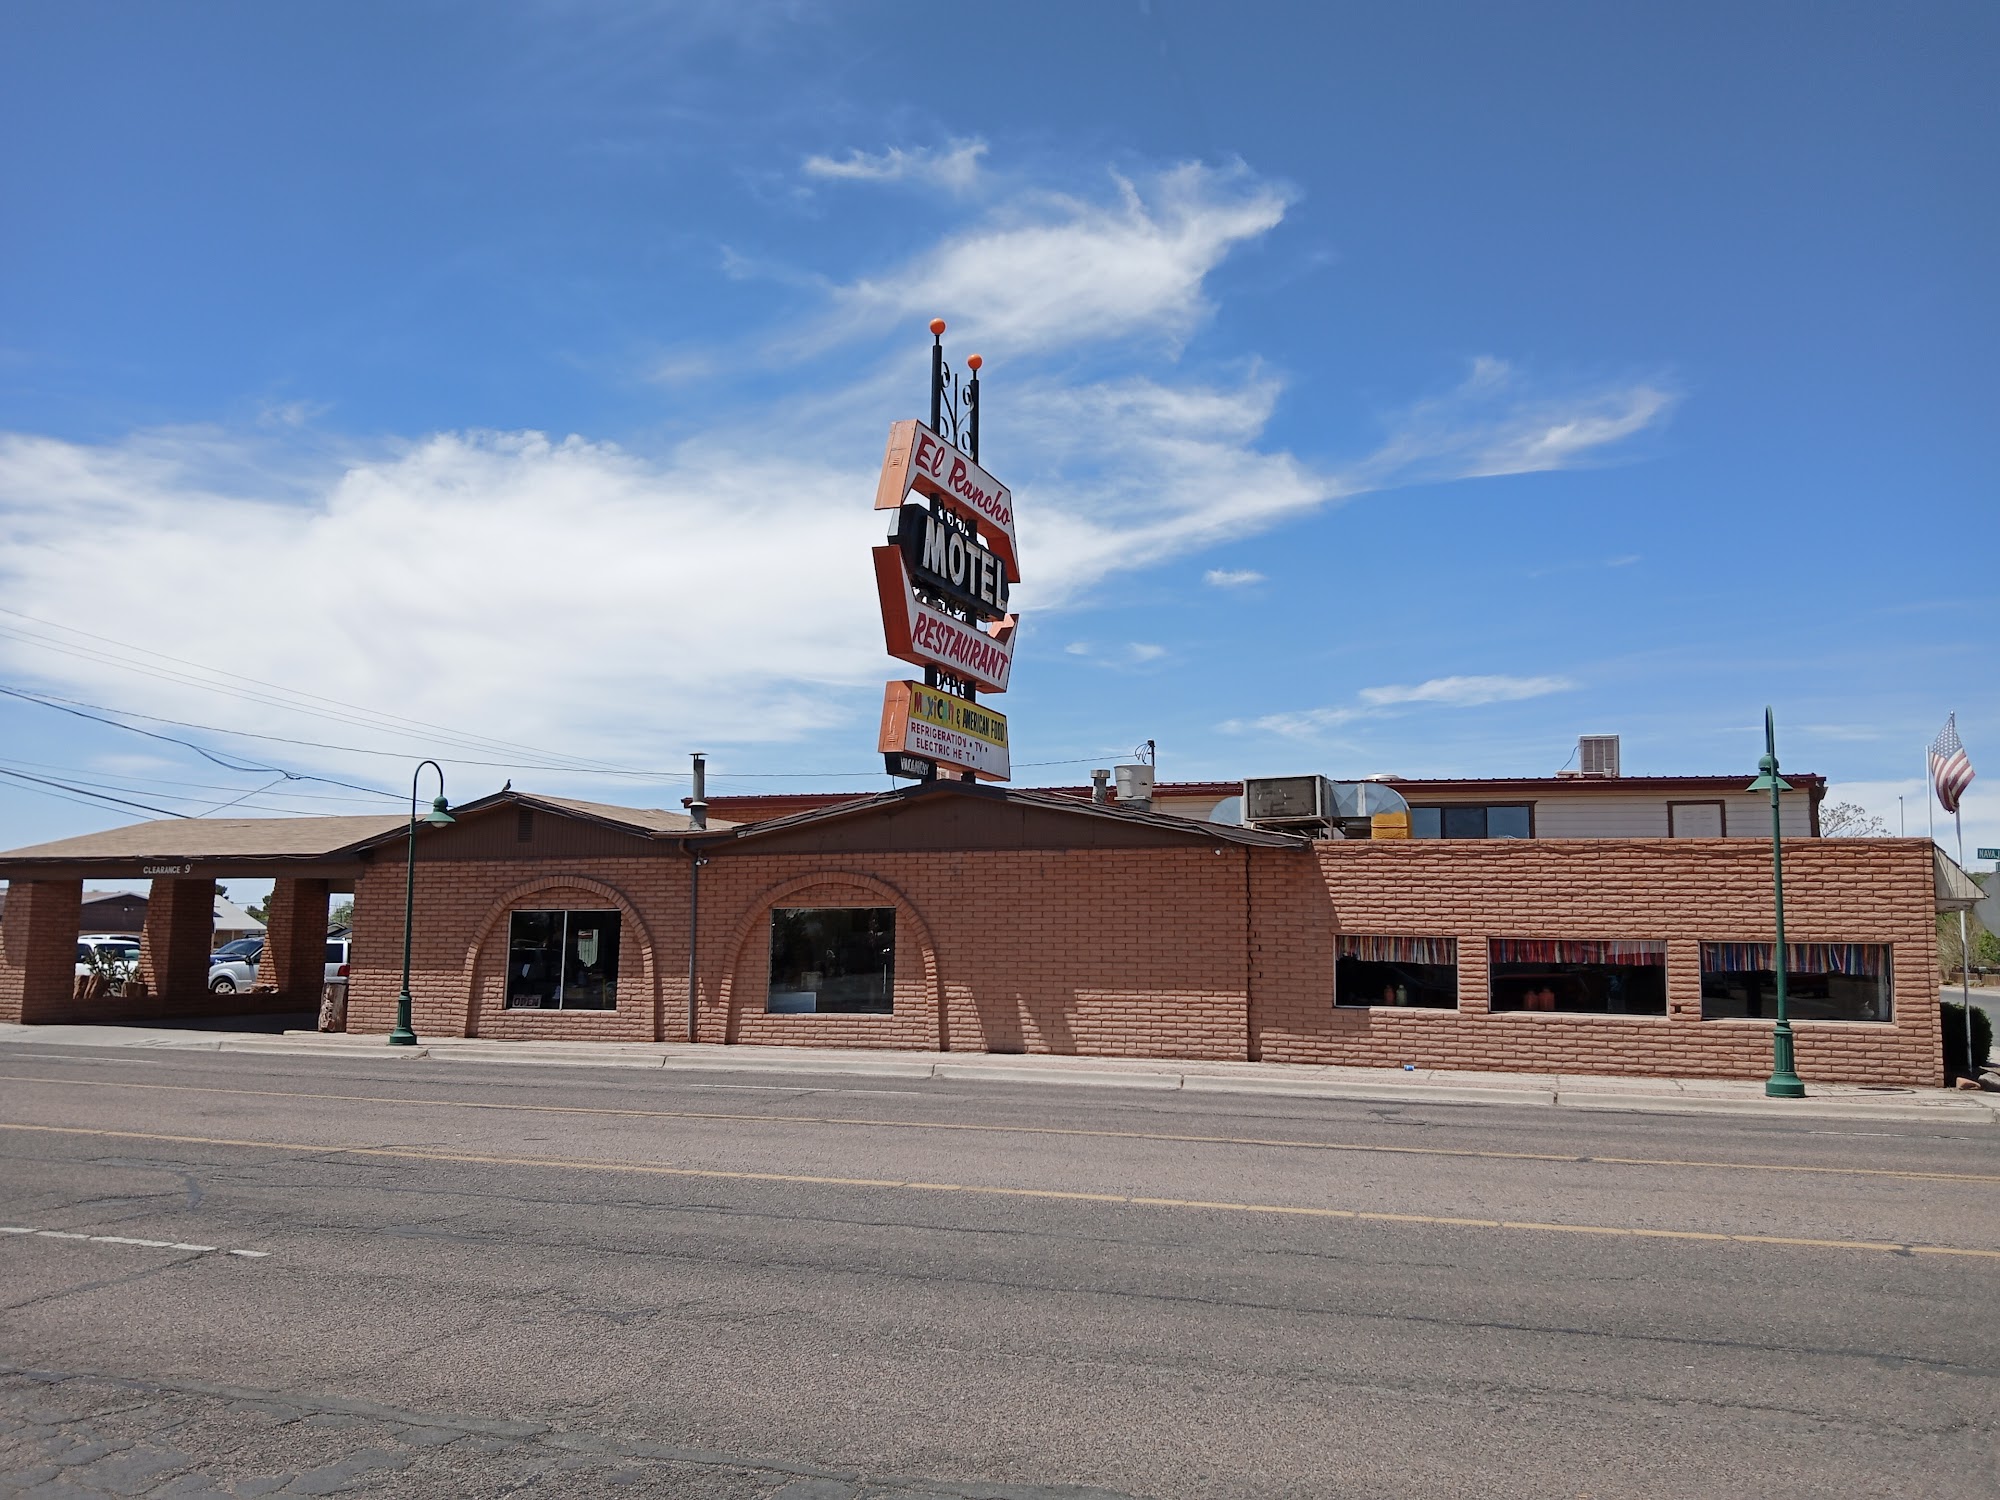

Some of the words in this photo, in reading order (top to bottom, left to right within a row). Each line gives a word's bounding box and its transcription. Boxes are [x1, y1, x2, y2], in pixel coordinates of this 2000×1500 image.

[914, 432, 946, 478] El
[947, 456, 1011, 526] Rancho
[922, 515, 1006, 612] MOTEL
[912, 611, 1009, 681] RESTAURANT
[911, 721, 967, 748] REFRIGERATION
[974, 741, 984, 753] TV
[962, 707, 989, 737] AMERICAN
[990, 719, 1005, 742] FOOD
[916, 737, 950, 757] ELECTRIC
[143, 866, 180, 874] CLEARANCE
[514, 997, 539, 1006] OPEN
